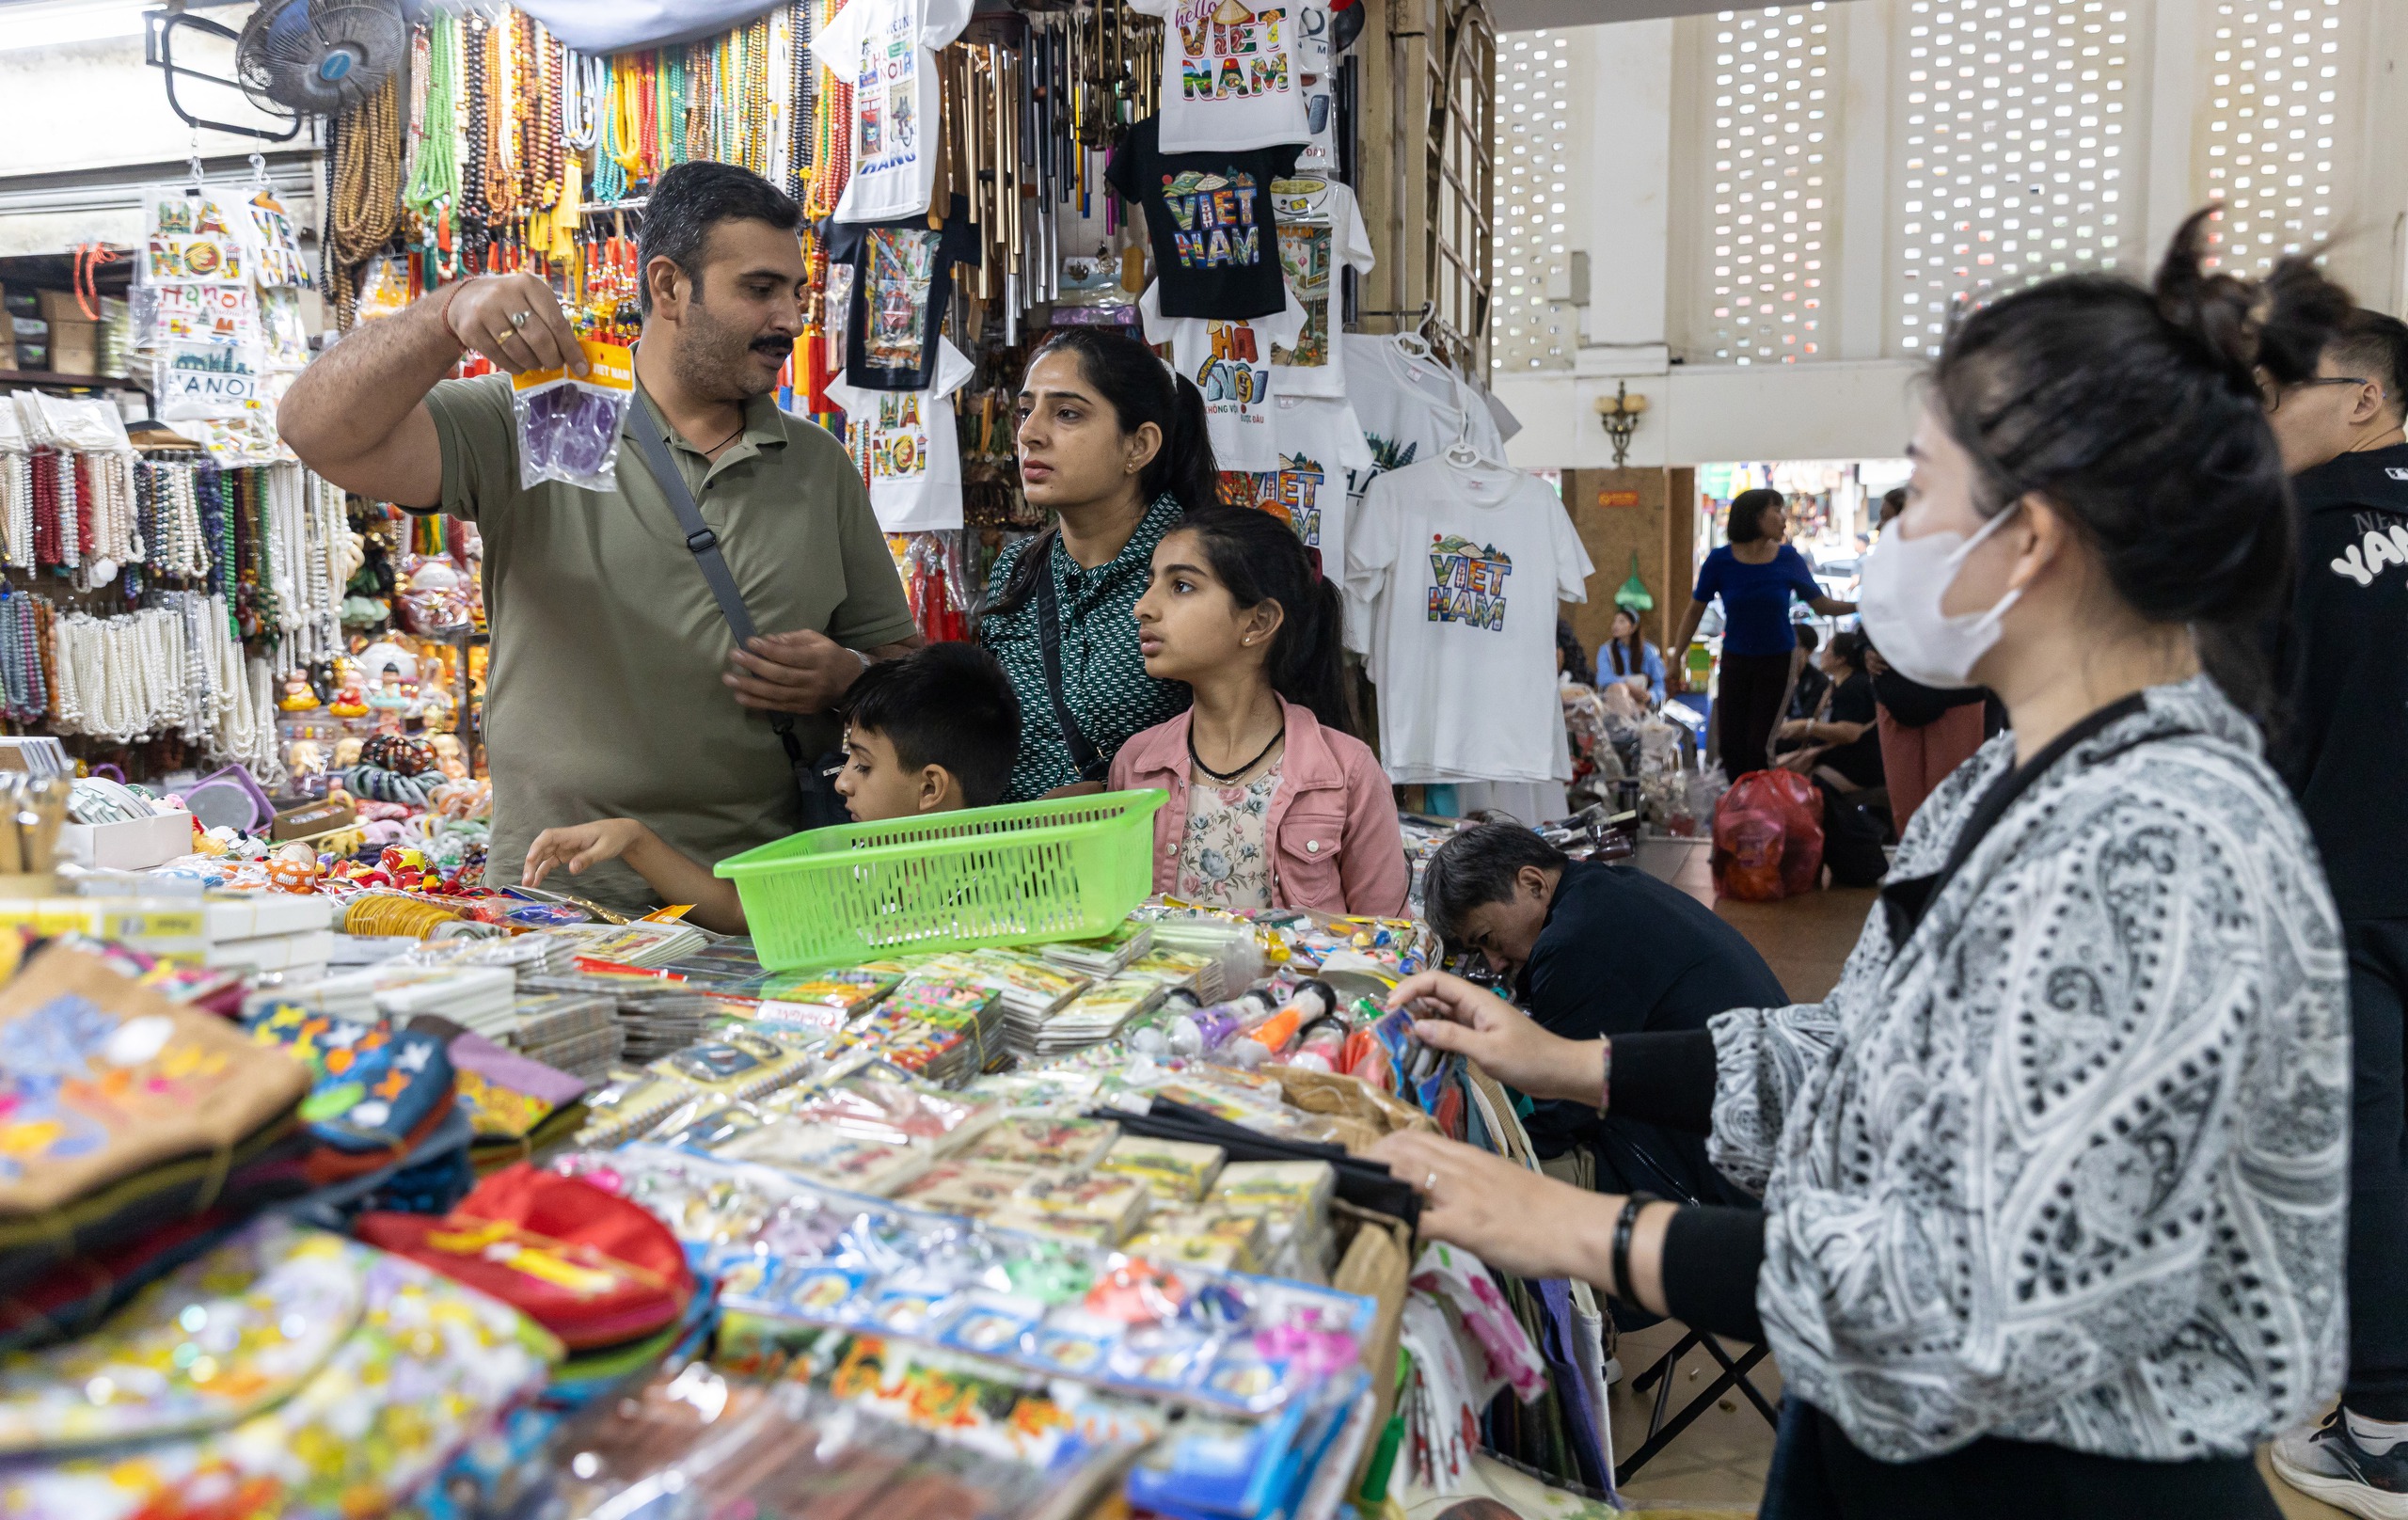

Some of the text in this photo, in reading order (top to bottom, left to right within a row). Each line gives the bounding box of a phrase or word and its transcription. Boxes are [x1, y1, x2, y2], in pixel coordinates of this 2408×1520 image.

[1175, 0, 1217, 28] hello
[1177, 8, 1289, 58] VIET
[1181, 52, 1291, 101] NAM
[1164, 187, 1258, 231] VIET
[1174, 226, 1259, 270] NAM
[1429, 554, 1513, 596] VIET
[1428, 586, 1507, 632] NAM
